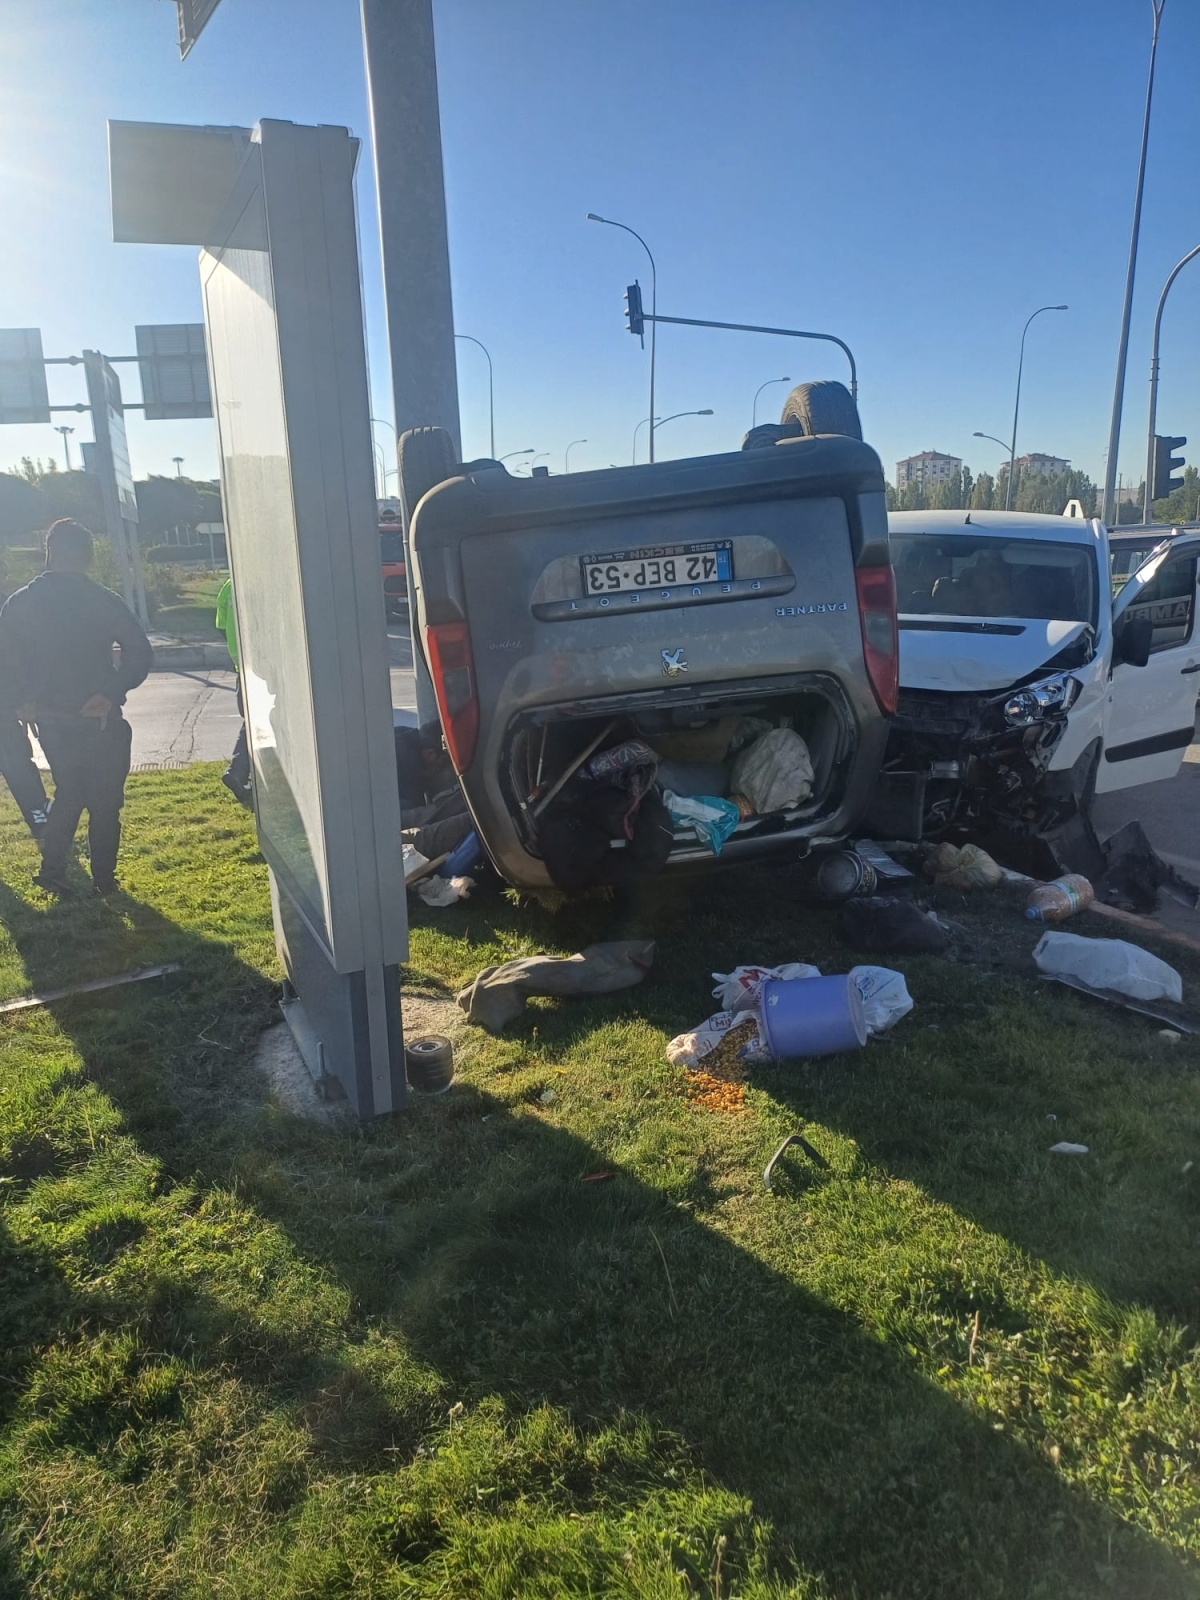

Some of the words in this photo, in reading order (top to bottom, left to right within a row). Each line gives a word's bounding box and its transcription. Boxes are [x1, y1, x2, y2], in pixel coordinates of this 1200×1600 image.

[589, 566, 620, 591] 53
[634, 559, 676, 586] BEP
[686, 556, 715, 581] 42
[569, 580, 761, 611] PEUGEOT
[775, 602, 848, 617] PARTNER
